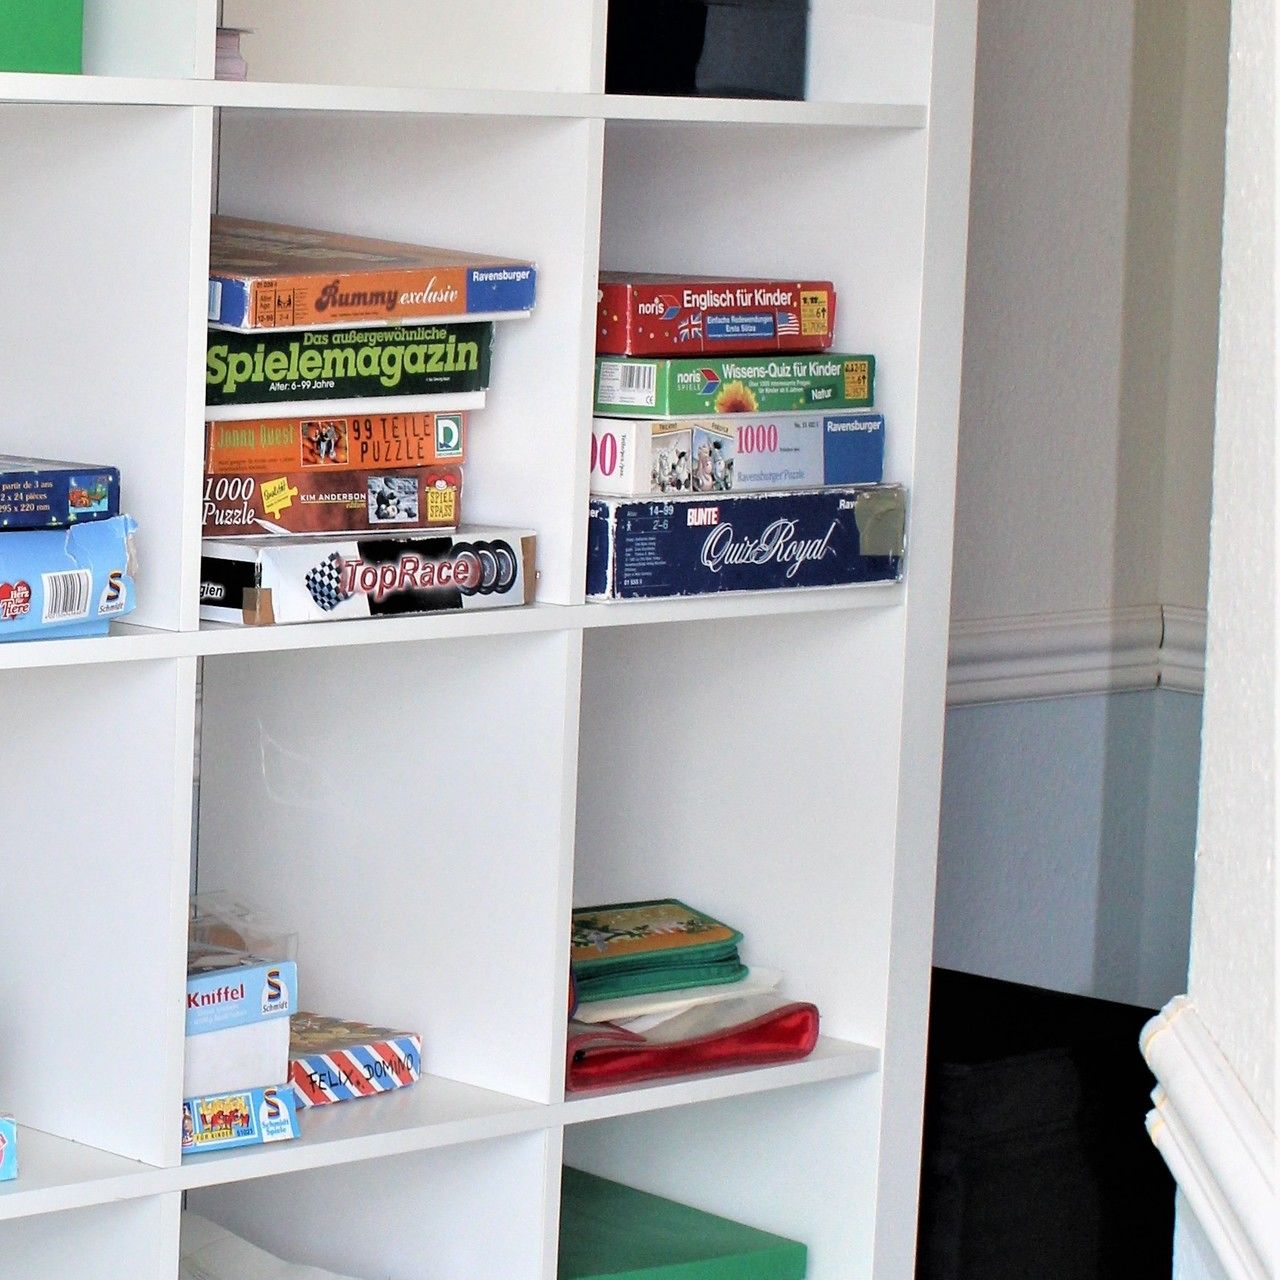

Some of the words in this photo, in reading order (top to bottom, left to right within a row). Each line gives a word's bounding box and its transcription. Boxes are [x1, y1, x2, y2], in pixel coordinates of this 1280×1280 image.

[472, 269, 531, 283] Ravensburger
[315, 279, 398, 311] Rummy
[400, 277, 458, 305] exclusiv
[683, 290, 736, 310] Englisch
[737, 289, 754, 307] für
[755, 289, 793, 306] Kinder
[638, 297, 665, 316] noris
[303, 332, 329, 346] Das
[332, 326, 448, 345] außergewöhnliche
[206, 335, 478, 393] Spielemagazin
[722, 363, 791, 379] Wissens-Quiz
[793, 362, 808, 377] für
[809, 361, 841, 376] Kinder
[312, 378, 335, 390] Jahre
[677, 371, 701, 383] noris
[812, 388, 832, 400] Natur
[352, 419, 373, 440] 99
[381, 415, 431, 439] TEILE
[827, 420, 881, 433] Ravensburger
[736, 424, 778, 454] 1000
[361, 437, 424, 462] PUZZLE
[22, 481, 32, 489] de
[203, 477, 255, 501] 1000
[300, 494, 316, 502] KIM
[318, 492, 367, 501] ANDERSON
[20, 503, 35, 512] 220
[202, 501, 255, 525] Puzzle
[653, 520, 669, 530] 2-6
[687, 508, 718, 526] BUNTE
[345, 556, 471, 599] TopRace
[10, 590, 29, 599] Herz
[1, 599, 30, 618] Tiere
[99, 602, 124, 613] Schmidt
[187, 984, 245, 1009] Kniffel
[262, 1001, 288, 1013] Schmidt
